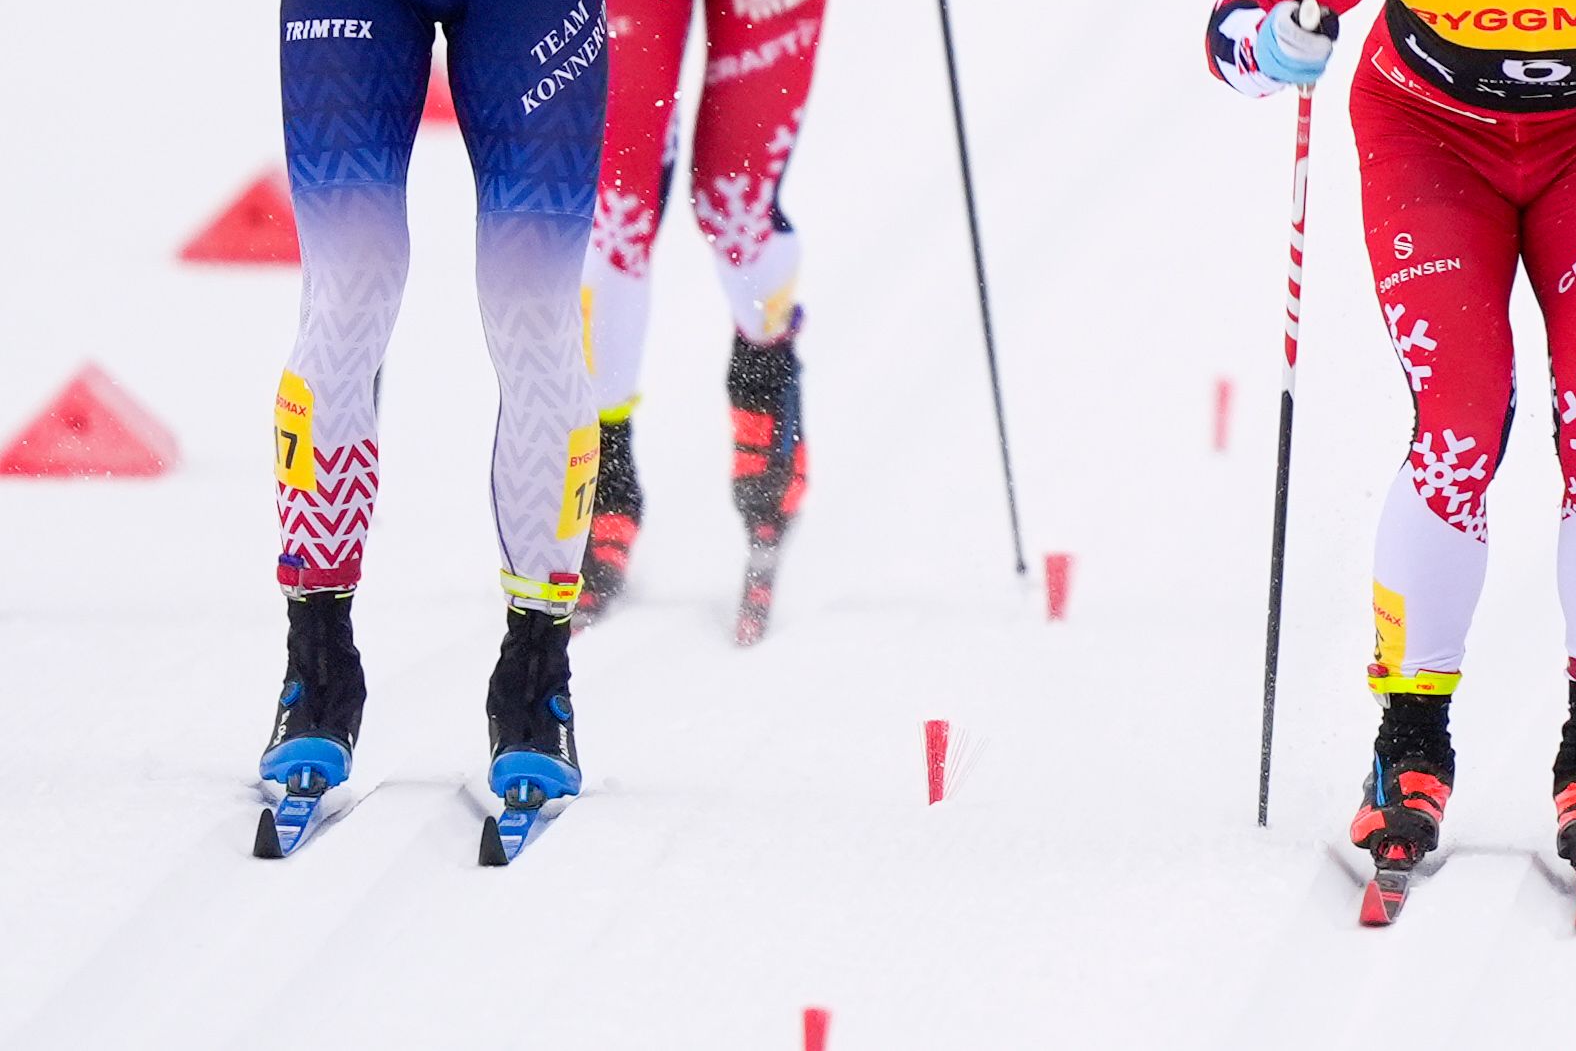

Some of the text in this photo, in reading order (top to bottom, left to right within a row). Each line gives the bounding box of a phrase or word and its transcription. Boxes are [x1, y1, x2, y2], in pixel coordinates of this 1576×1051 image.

[286, 19, 373, 42] TRIMTEX
[530, 0, 590, 66] TEAM
[520, 0, 607, 115] KONNERU
[1379, 257, 1462, 294] SØRENSEN
[274, 425, 298, 470] 17
